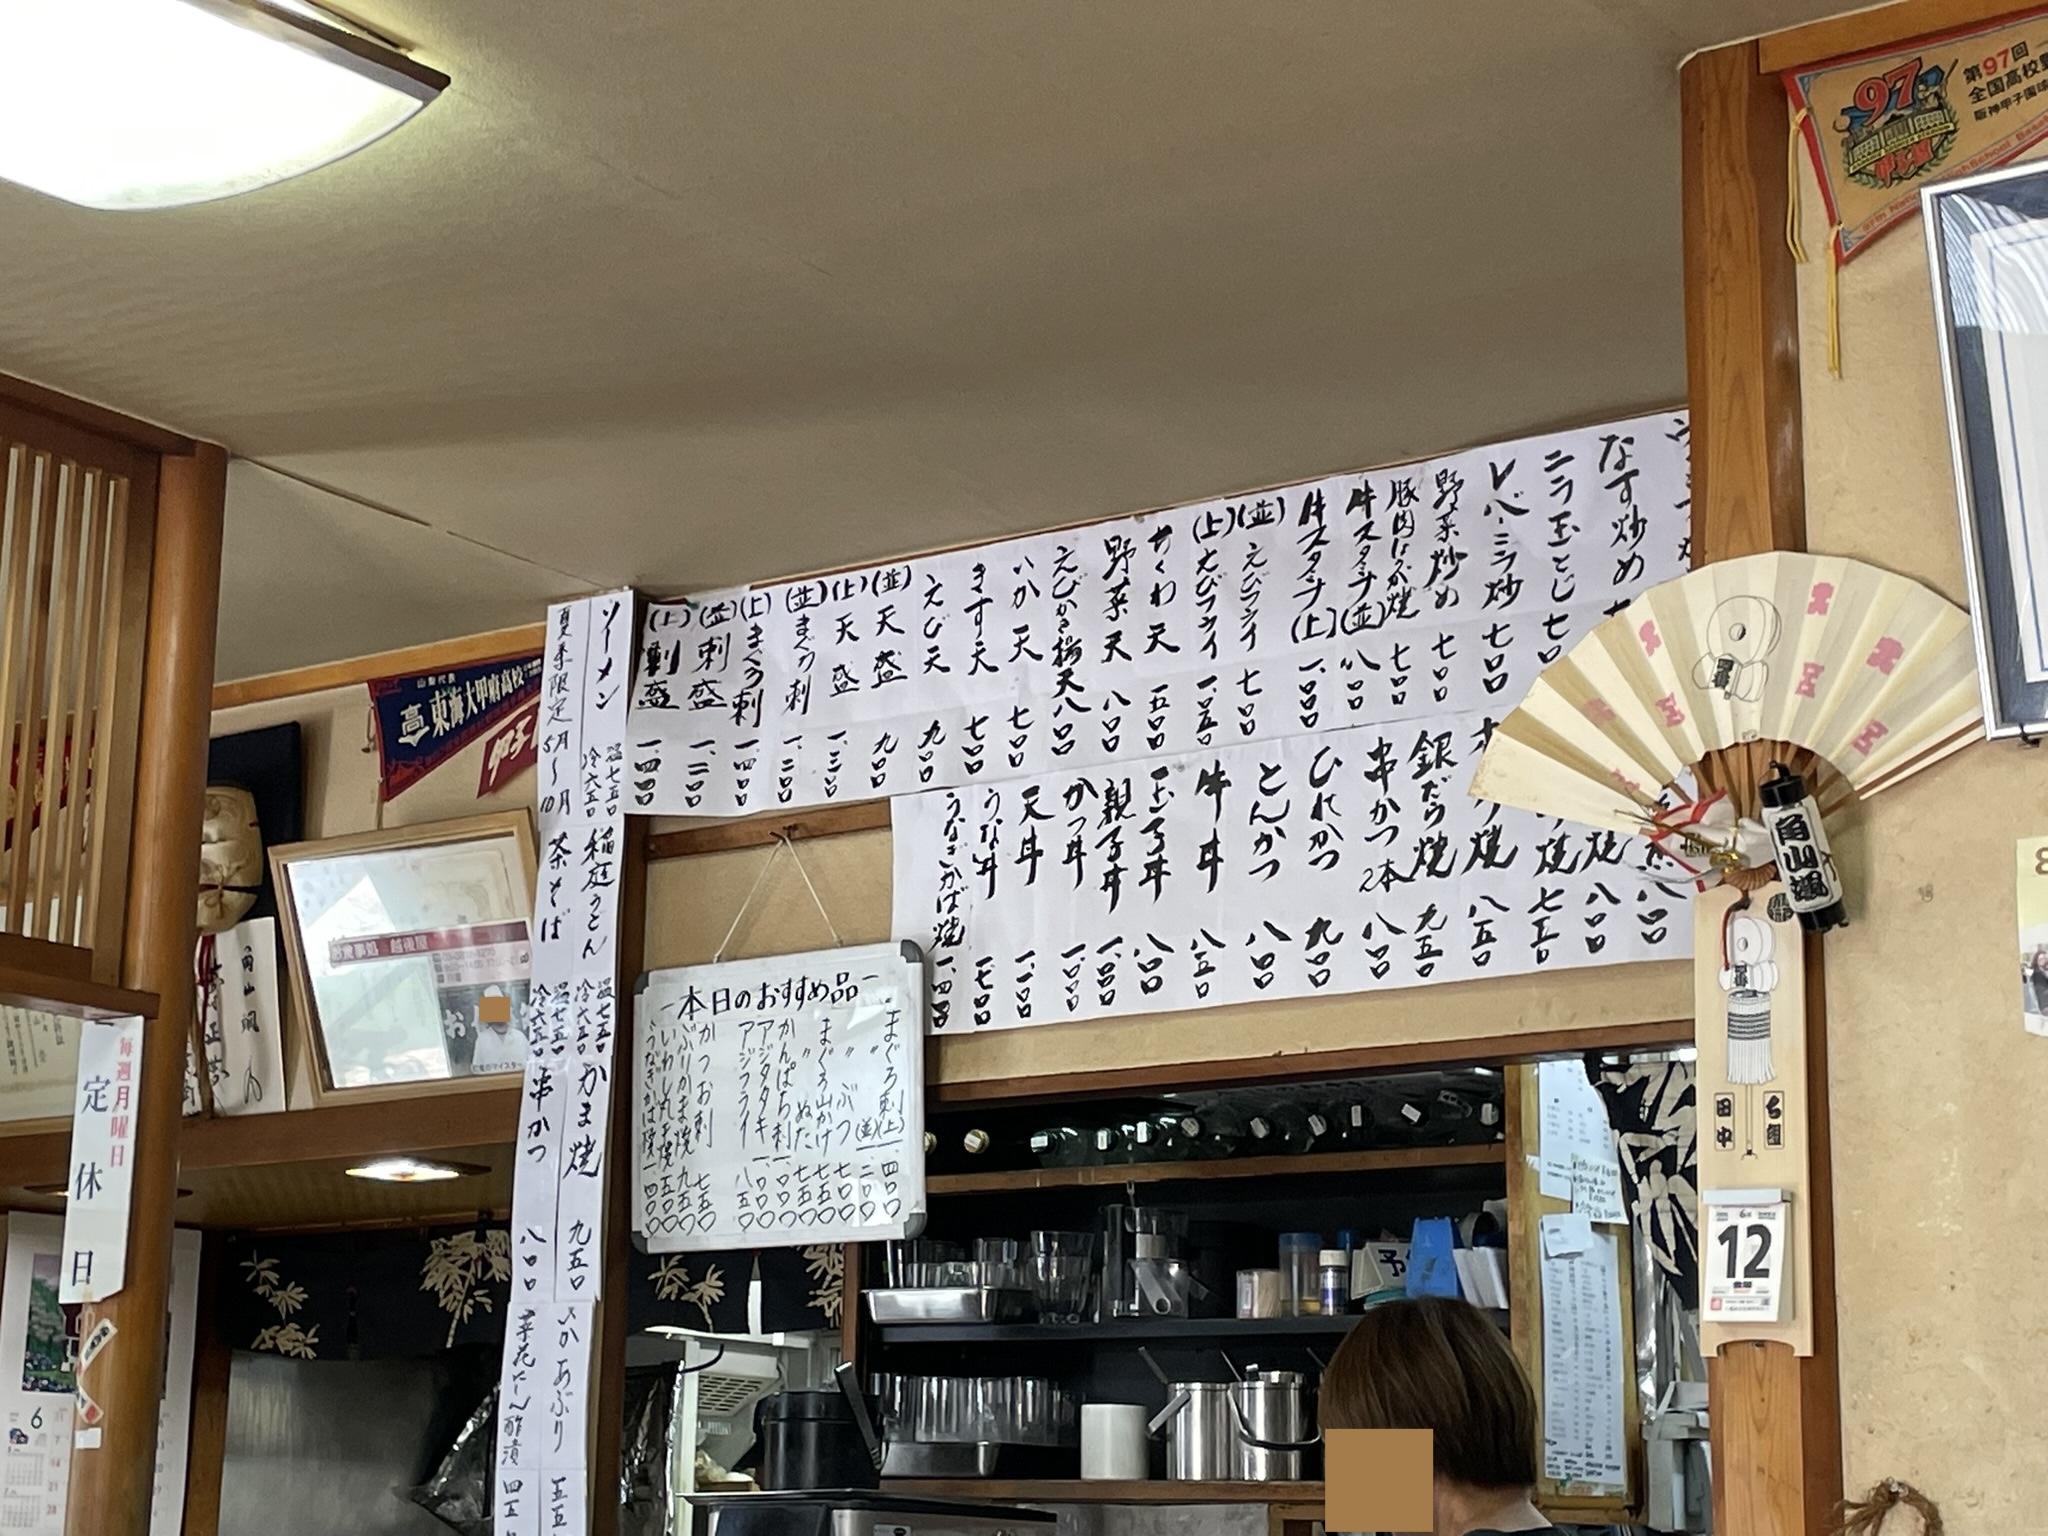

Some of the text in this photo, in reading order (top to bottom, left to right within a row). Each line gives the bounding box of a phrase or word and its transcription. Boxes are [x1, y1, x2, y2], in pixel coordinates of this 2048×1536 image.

[1854, 56, 1922, 126] 97
[1963, 40, 2029, 84] 第97回
[1424, 468, 1468, 609] 野菜炒め
[1543, 450, 1581, 603] ニラ玉とじ
[1599, 434, 1647, 585] なす炒め
[923, 574, 951, 674] えび天
[964, 562, 999, 675] きす天
[1008, 555, 1043, 663] いか天
[1101, 535, 1137, 664] 野菜天
[1143, 525, 1180, 655] ちくわ天
[429, 665, 524, 738] 東海大甲府高校
[547, 605, 573, 726] 夏季限定
[596, 600, 620, 709] ソーメン
[972, 788, 1003, 900] うな丼
[1014, 785, 1056, 887] 天丼
[1062, 777, 1099, 891] かつ丼
[1095, 778, 1136, 914] 親子丼
[1138, 766, 1175, 903] 玉子丼
[1195, 759, 1232, 893] 牛丼
[1249, 762, 1291, 882] とんかつ
[1308, 746, 1344, 871] ひれかつ
[541, 832, 572, 942] 茶そば
[109, 1037, 134, 1168] 毎週月曜日
[527, 1065, 554, 1163] 串かつ
[563, 1064, 607, 1180] かま焼
[694, 1022, 716, 1148] かつお刺
[738, 1021, 755, 1149] アジフライ
[72, 1074, 111, 1287] 定休日
[1377, 1249, 1410, 1277] 予
[1717, 1224, 1772, 1279] 12
[30, 1407, 43, 1429] 6
[551, 1307, 579, 1453] いかあぶり
